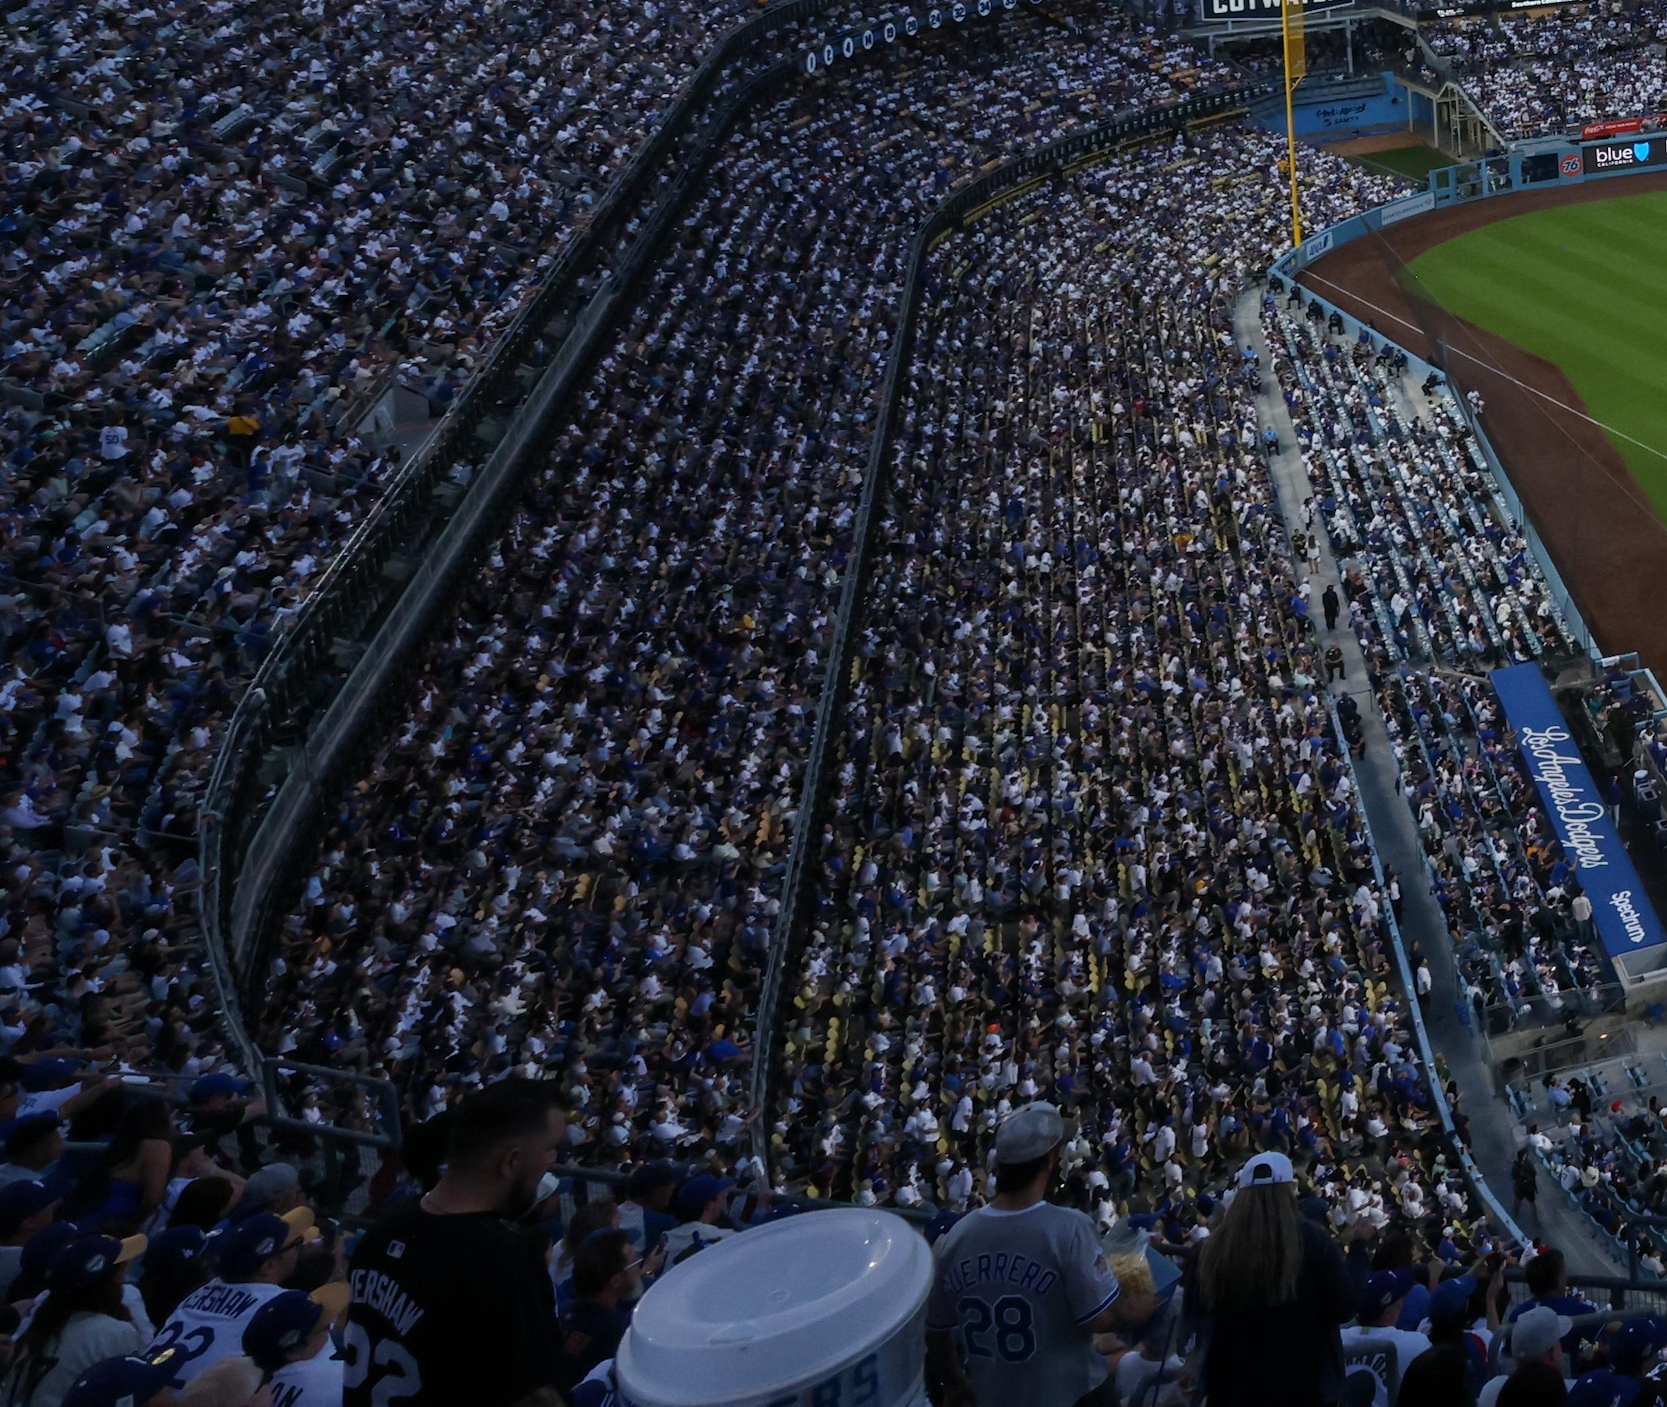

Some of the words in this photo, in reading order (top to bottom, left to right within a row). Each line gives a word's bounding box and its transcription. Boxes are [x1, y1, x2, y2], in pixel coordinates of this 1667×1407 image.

[954, 8, 965, 18] 32
[979, 1, 990, 12] 34
[930, 14, 941, 25] 24
[1596, 146, 1633, 161] blue
[1562, 159, 1579, 172] 76
[1597, 159, 1634, 167] CALIFORNIA
[1522, 725, 1569, 756] Los
[1534, 748, 1584, 807] Angeles
[1559, 802, 1609, 870] Dodgers
[1611, 890, 1646, 944] Spectrum
[957, 1294, 1036, 1363] 28
